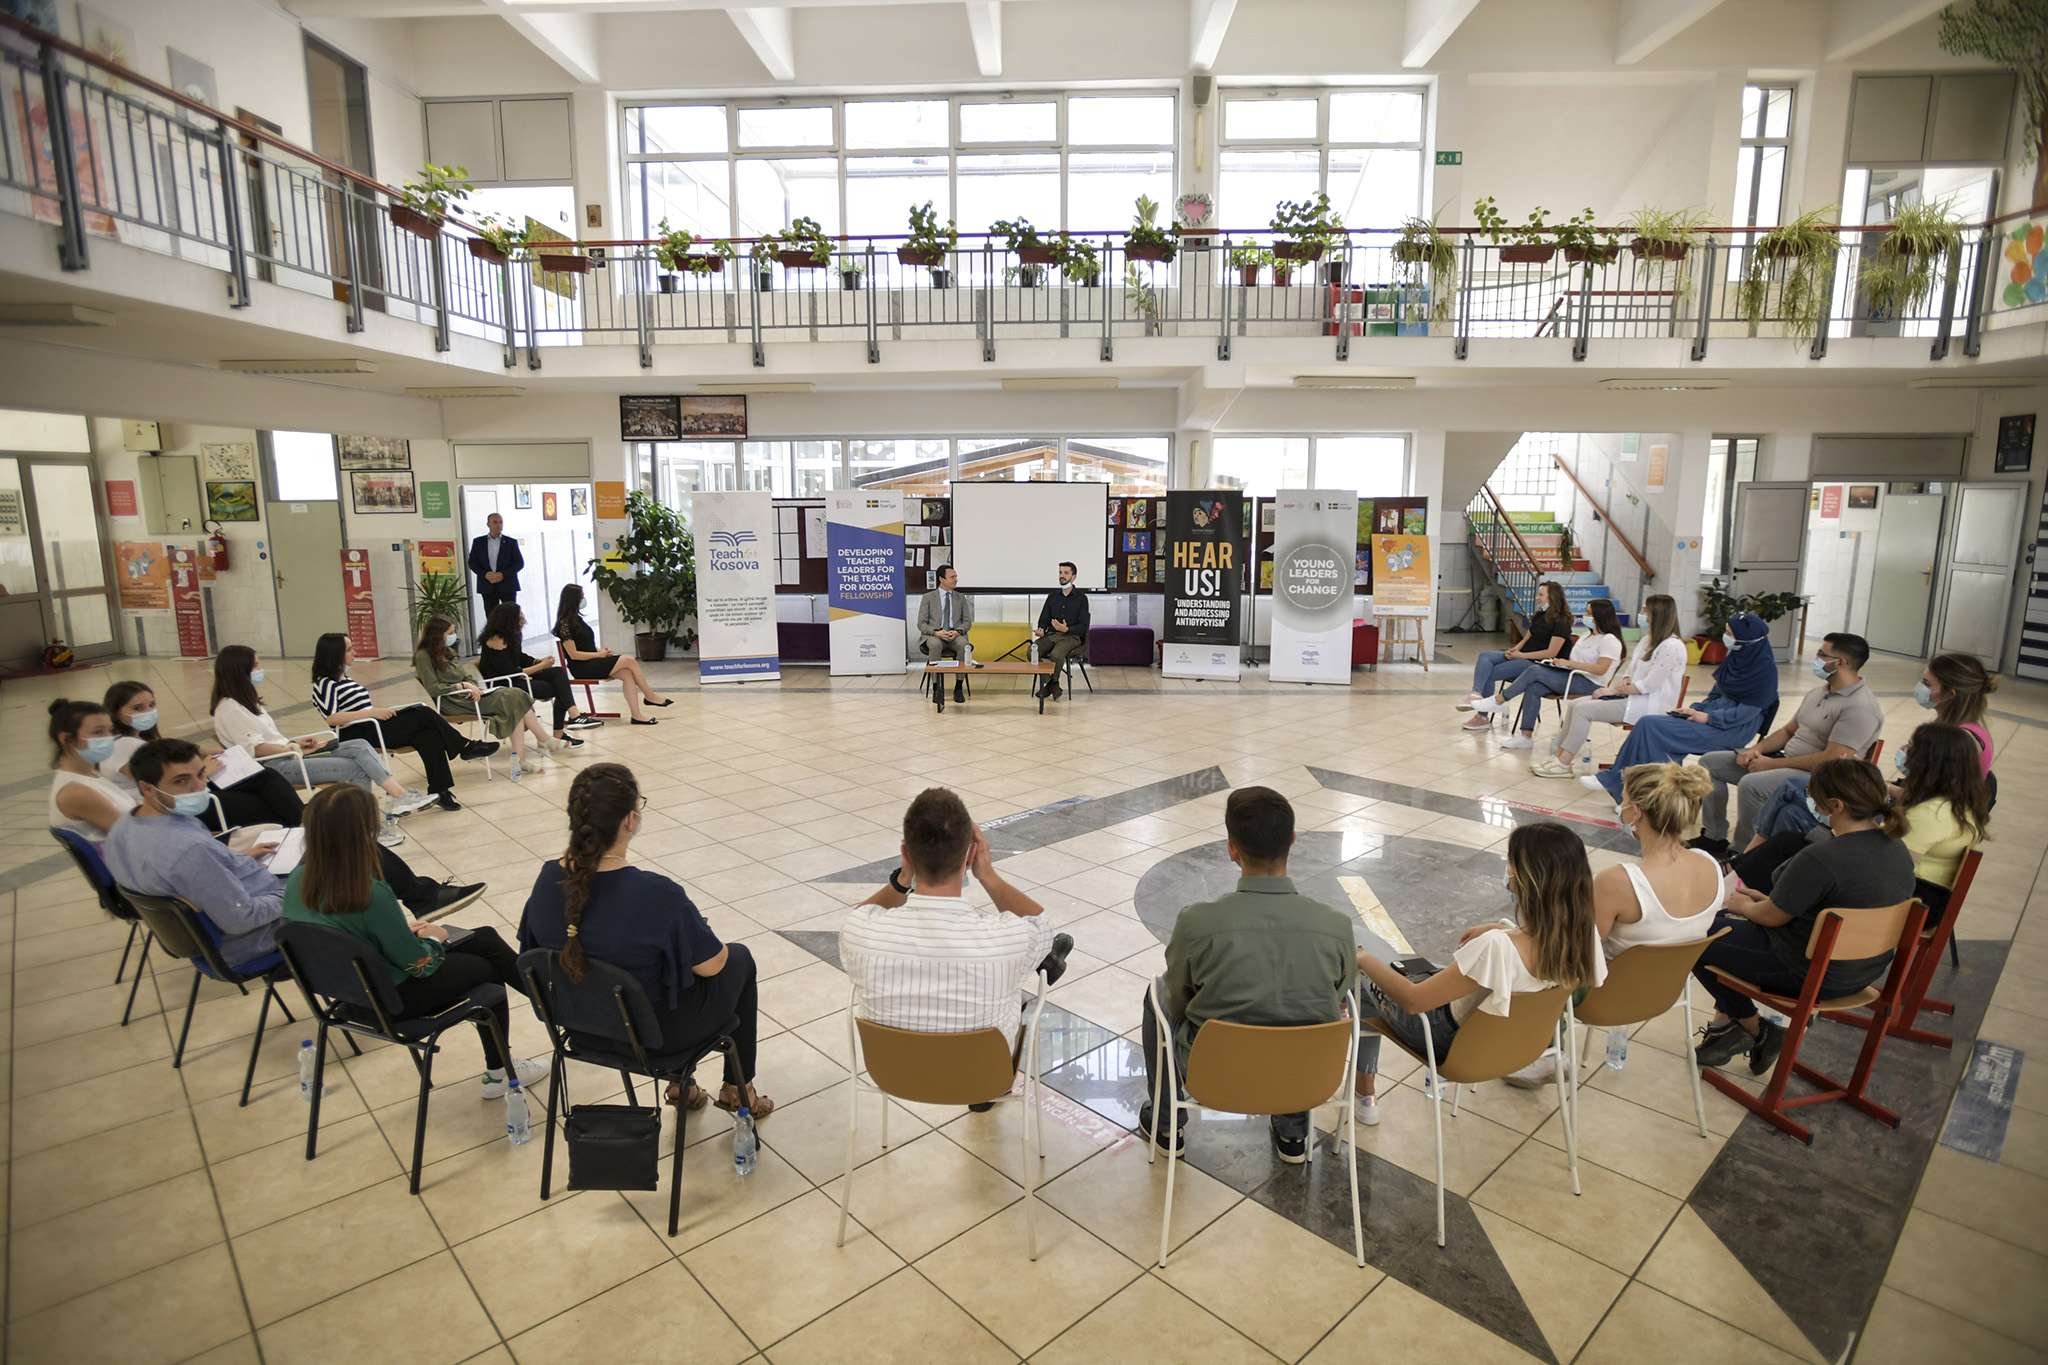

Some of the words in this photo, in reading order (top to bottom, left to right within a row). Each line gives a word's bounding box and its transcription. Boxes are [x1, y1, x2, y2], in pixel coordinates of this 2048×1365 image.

[709, 548, 744, 560] Teach
[837, 548, 894, 557] DEVELOPING
[1173, 541, 1233, 569] HEAR
[710, 560, 760, 571] Kosova
[845, 557, 886, 565] TEACHER
[1293, 559, 1335, 569] YOUNG
[837, 566, 876, 574] LEADERS
[877, 565, 895, 573] FOR
[1289, 568, 1339, 579] LEADERS
[842, 574, 860, 582] THE
[862, 574, 890, 582] TEACH
[1184, 568, 1221, 597] US!
[839, 583, 857, 591] FOR
[859, 583, 894, 591] KOSOVA
[1288, 584, 1338, 595] CHANGE
[840, 591, 894, 600] FELLOWSHIP
[1174, 608, 1188, 617] AND
[1188, 608, 1230, 618] ADDRESSING
